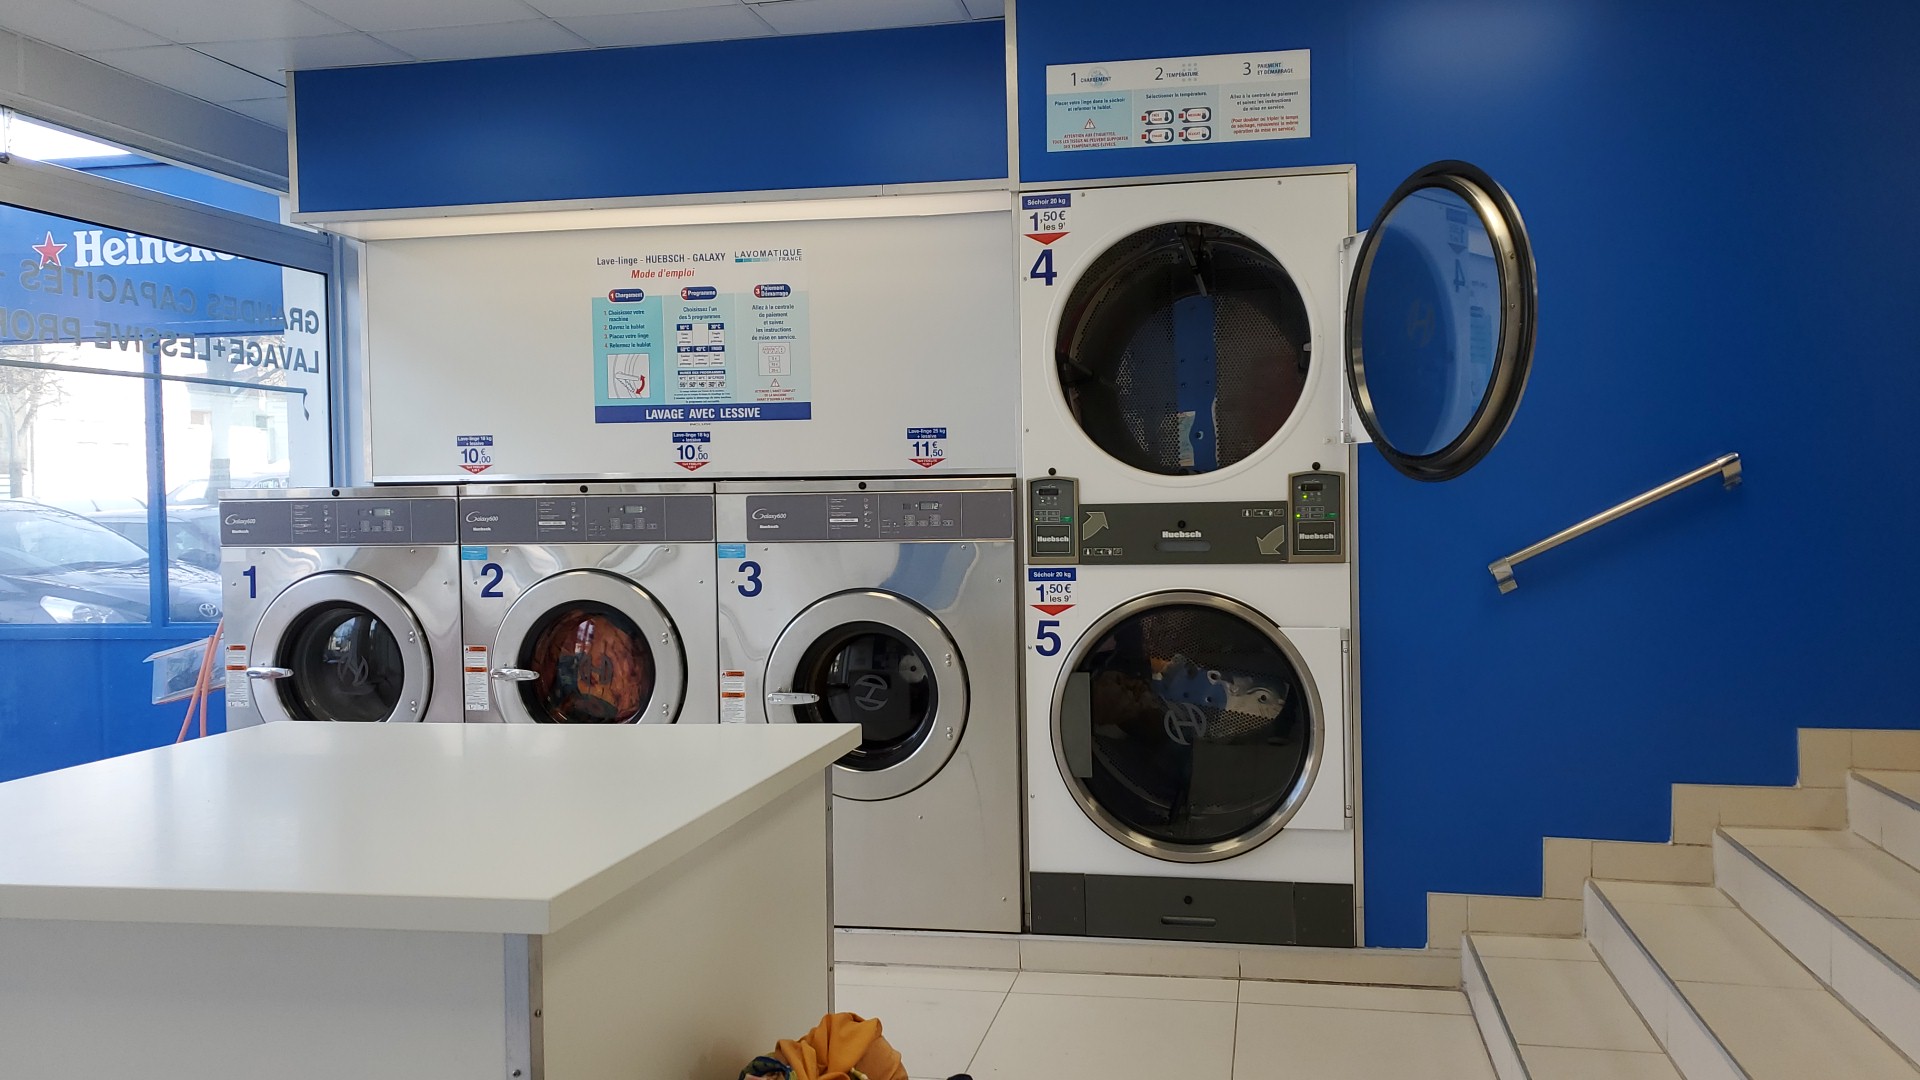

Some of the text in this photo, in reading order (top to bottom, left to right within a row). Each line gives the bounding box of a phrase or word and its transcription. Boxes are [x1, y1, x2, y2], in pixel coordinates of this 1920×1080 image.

[1154, 66, 1164, 81] 2
[1242, 62, 1252, 76] 3
[1070, 72, 1077, 87] 1
[1027, 198, 1049, 206] Séchoir
[1058, 197, 1066, 205] kg
[1043, 223, 1056, 231] les
[596, 256, 639, 266] Lave-linge
[645, 253, 685, 264] HUEBSCH
[692, 252, 726, 262] GALAXY
[734, 248, 803, 258] LAVOMATIQUE
[631, 267, 695, 279] Mode d'emploi
[1030, 248, 1058, 287] 4
[615, 291, 643, 299] Chargement
[645, 407, 761, 420] LAVAGE AVEC LESSIVE
[1037, 535, 1069, 543] Huebsch
[1161, 530, 1202, 539] Huebsch
[1299, 532, 1335, 540] Huebsch
[480, 562, 504, 598] 2
[737, 560, 763, 598] 3
[1063, 571, 1072, 579] kg
[242, 565, 257, 599] 1
[1049, 594, 1062, 602] les
[1035, 620, 1062, 657] 5
